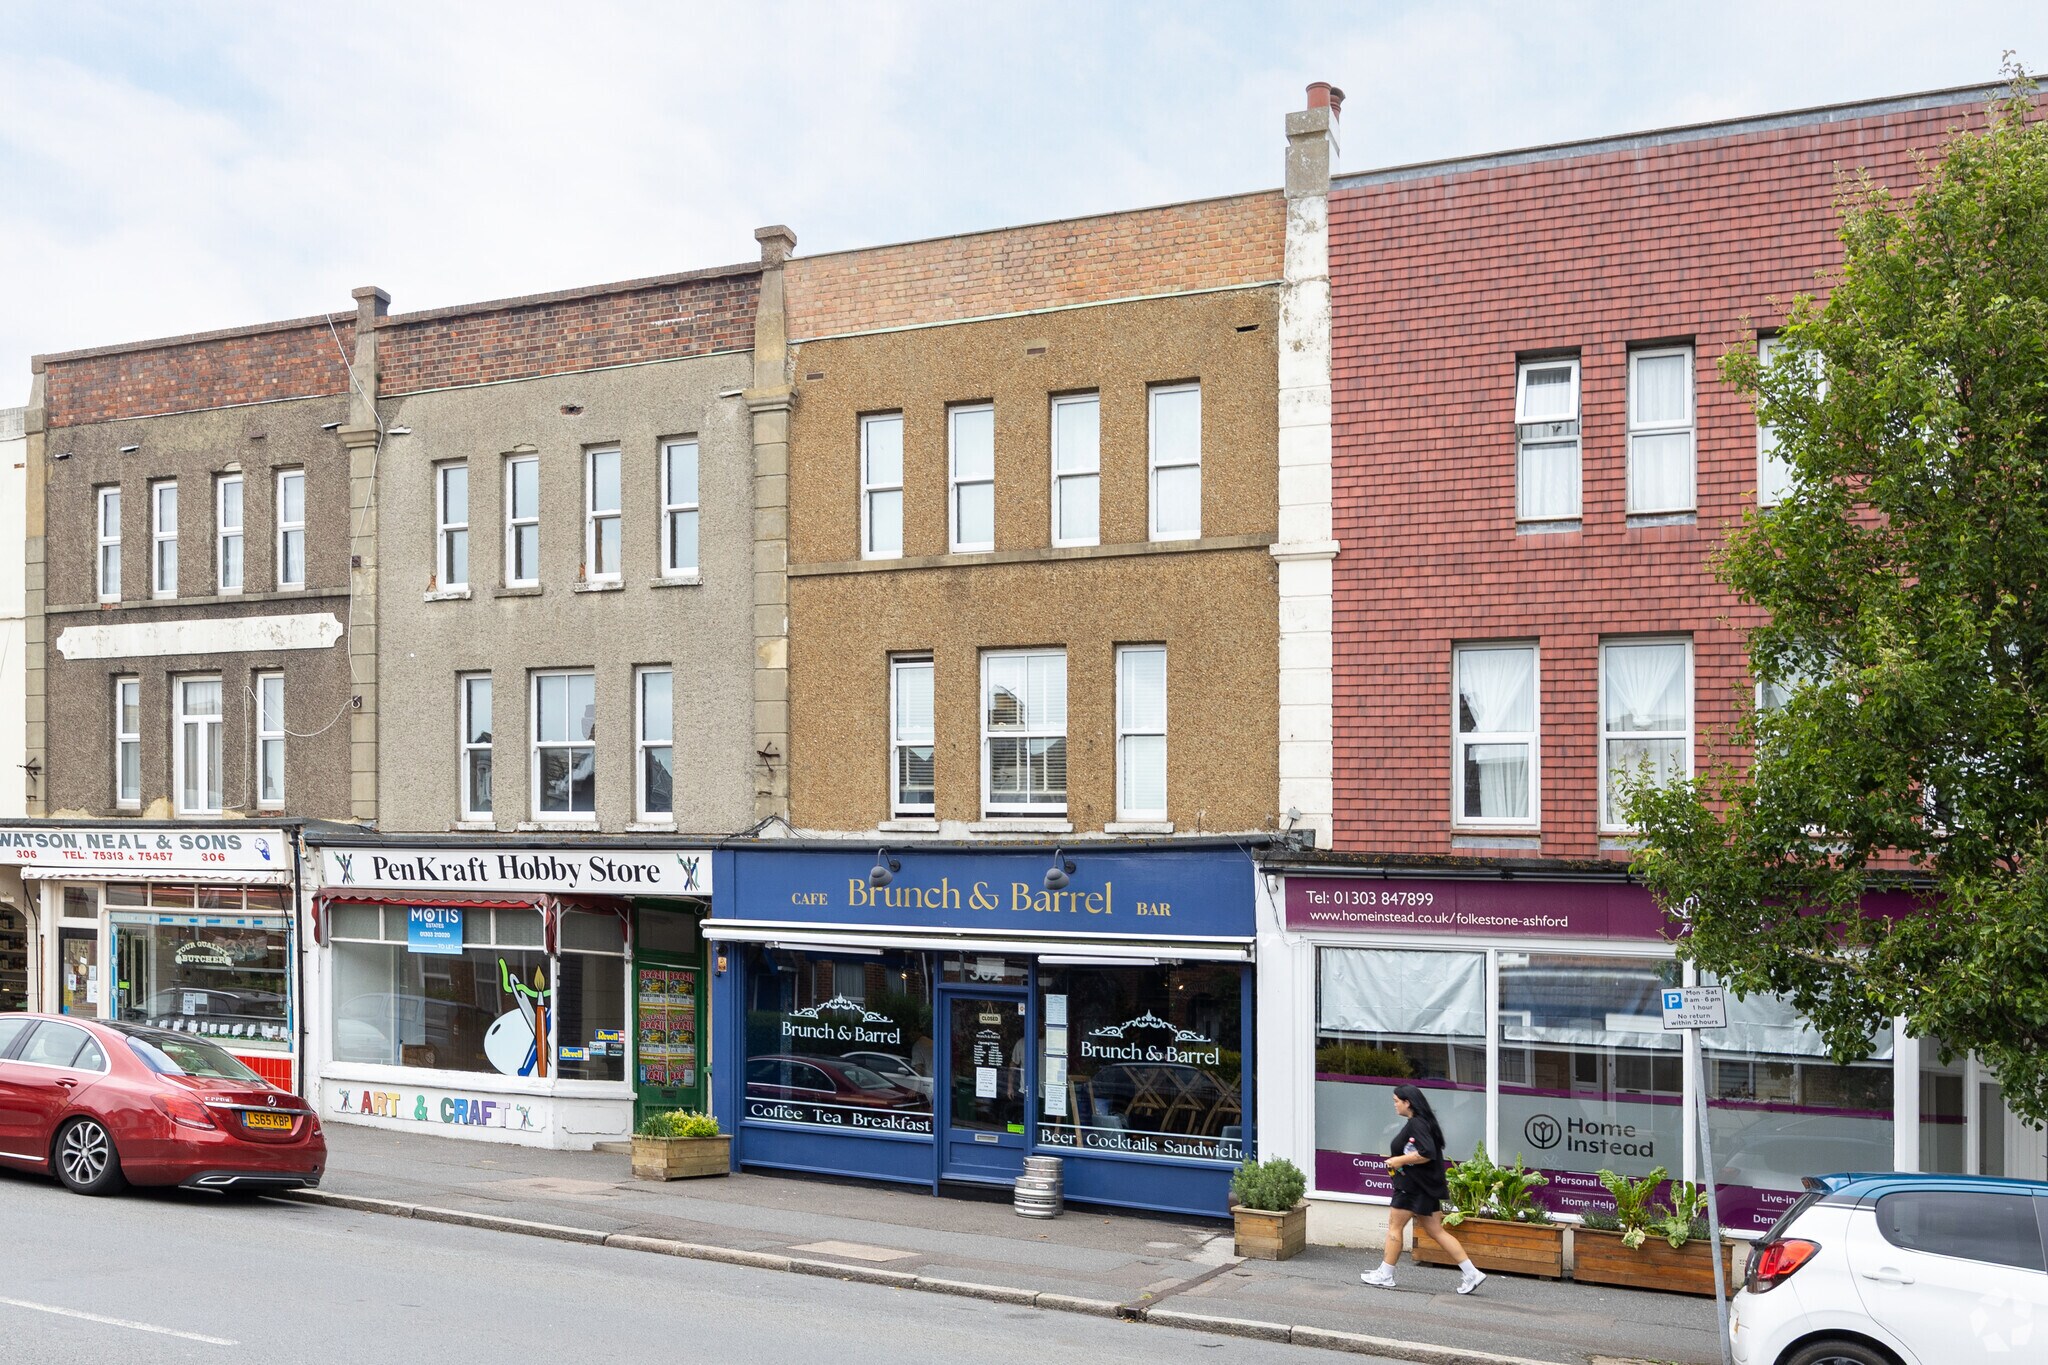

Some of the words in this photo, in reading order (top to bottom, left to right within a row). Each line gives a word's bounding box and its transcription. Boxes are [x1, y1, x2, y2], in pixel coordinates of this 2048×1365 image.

[0, 833, 82, 850] WATSON,
[86, 833, 147, 849] NEAL
[156, 834, 173, 850] &
[179, 834, 242, 850] SONS
[16, 850, 37, 858] 306
[63, 851, 87, 859] TEL:
[93, 851, 124, 860] 75313
[138, 852, 173, 861] 75457
[201, 853, 226, 861] 306
[371, 856, 489, 881] PenKraft
[496, 855, 582, 888] Hobby
[589, 856, 661, 883] Store
[791, 893, 828, 906] CAFE
[848, 877, 961, 909] Brunch
[968, 881, 1000, 910] &
[1011, 881, 1113, 915] Barrel
[1306, 890, 1330, 904] Tel:
[1334, 891, 1377, 905] 01303
[1381, 892, 1434, 906] 847899
[411, 908, 459, 923] MOTIS
[1136, 902, 1172, 917] BAR
[1310, 910, 1568, 927] www.homeinstead.co.uk/folkestone-ashford
[176, 942, 196, 955] YOUR
[196, 941, 229, 957] QUALITY
[181, 954, 226, 964] BUTCHER
[1668, 995, 1680, 1008] P
[597, 1030, 618, 1040] Revell
[781, 1021, 835, 1040] Brunch
[837, 1025, 852, 1041] &
[855, 1026, 901, 1045] Barrel
[561, 1048, 583, 1058] Revell
[1081, 1041, 1142, 1060] Brunch
[1145, 1045, 1162, 1061] &
[1166, 1046, 1220, 1065] Barrel
[361, 1090, 400, 1117] ART
[414, 1095, 428, 1120] &
[440, 1097, 510, 1128] CRAFT
[248, 1114, 271, 1125] LS65
[273, 1116, 289, 1126] KBP
[751, 1104, 803, 1120] Coffee
[813, 1109, 842, 1124] Tea
[852, 1112, 931, 1132] Breakfast
[1568, 1117, 1636, 1138] Home
[1041, 1129, 1077, 1145] Beer
[1086, 1134, 1158, 1152] Cocktails
[1568, 1135, 1654, 1158] Instead
[1555, 1175, 1597, 1187] Personal
[1561, 1197, 1590, 1206] Home
[1592, 1200, 1615, 1211] Help
[1761, 1193, 1796, 1204] Live-in
